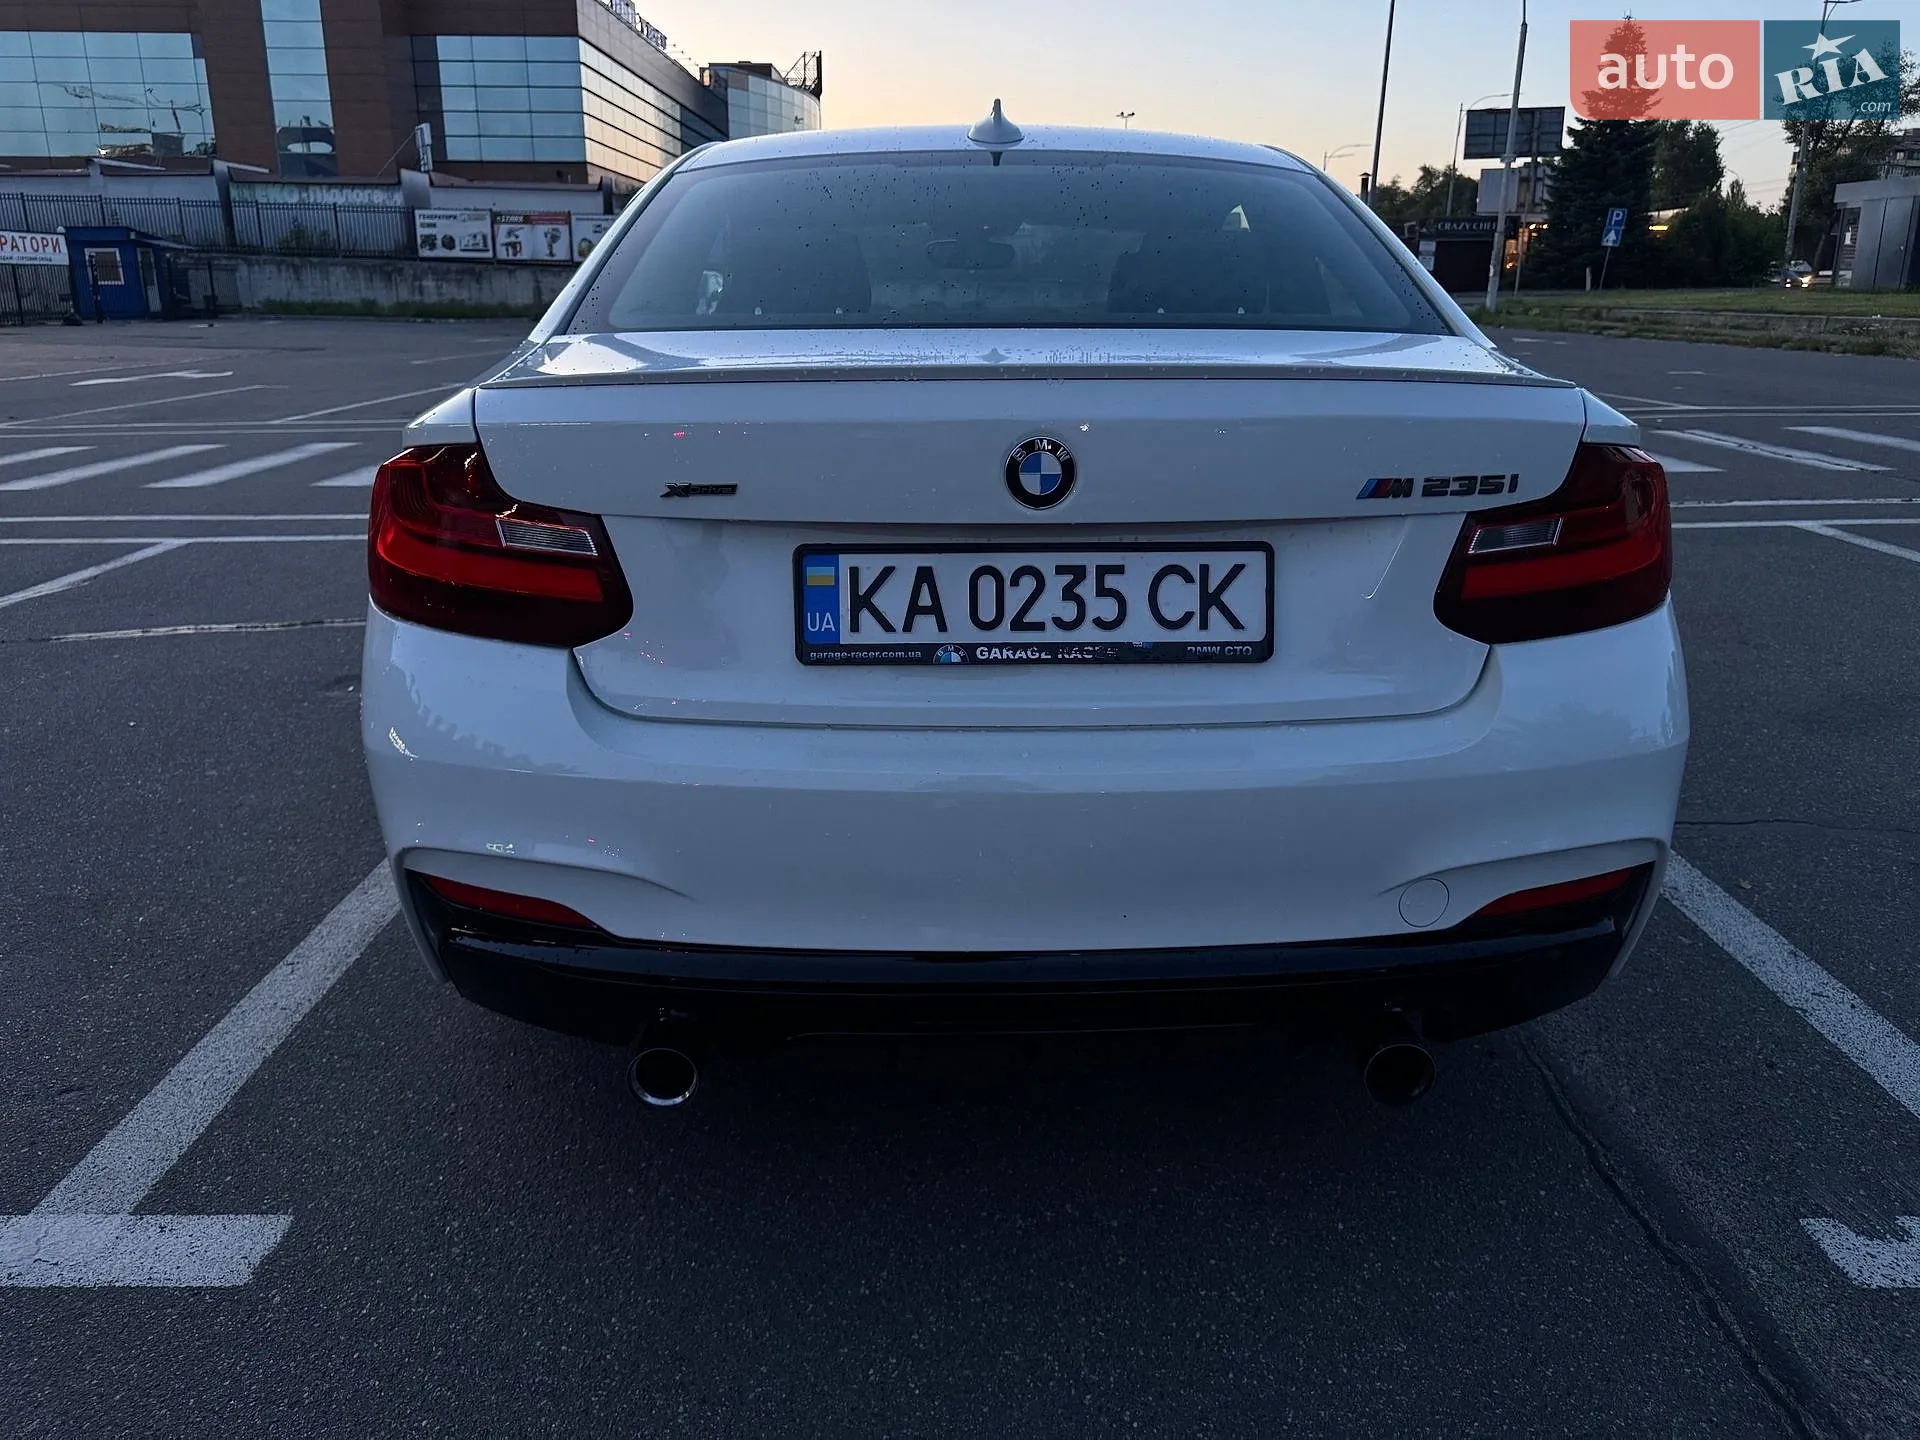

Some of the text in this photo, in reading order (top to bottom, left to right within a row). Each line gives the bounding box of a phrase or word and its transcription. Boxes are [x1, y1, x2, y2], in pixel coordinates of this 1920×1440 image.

[1611, 210, 1623, 225] P
[1437, 221, 1471, 232] CRAZY
[1012, 439, 1071, 463] BMW
[849, 563, 1247, 632] KA 0235 CK
[807, 612, 836, 632] UA
[810, 651, 922, 661] garage-racer.com.ua
